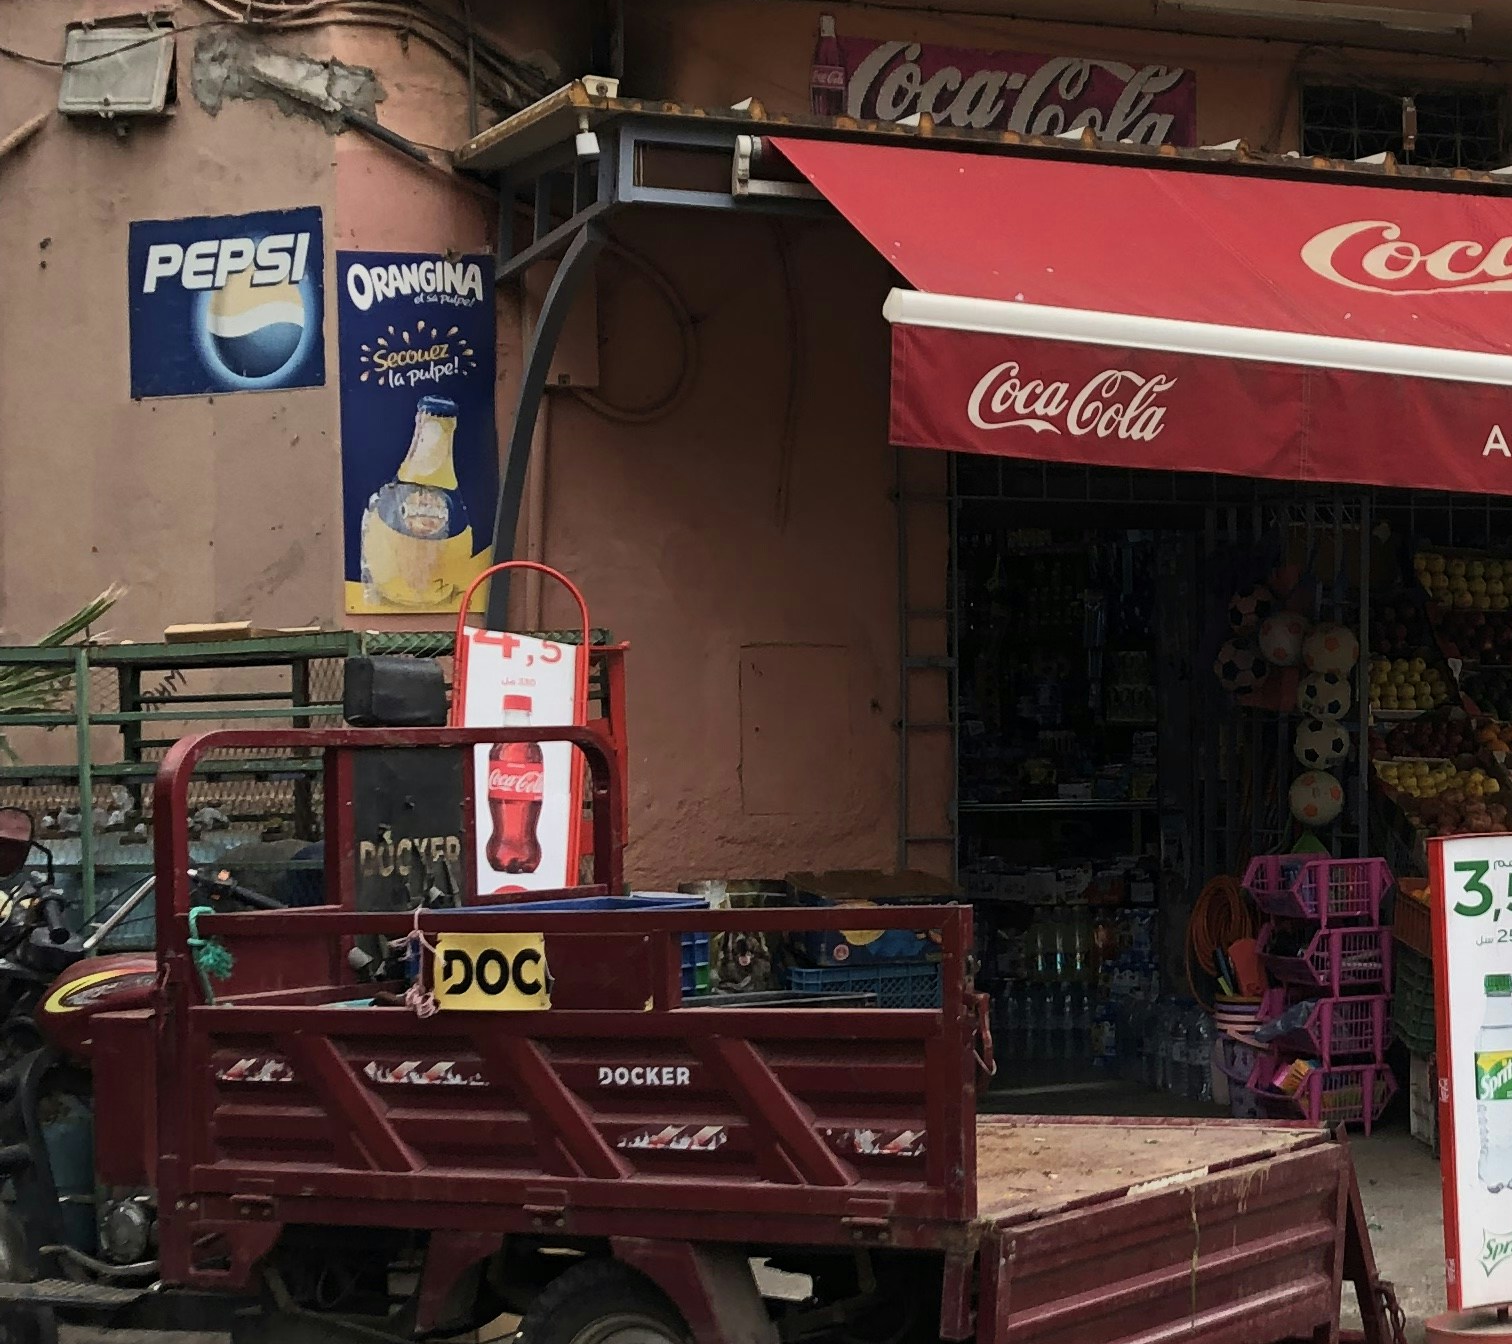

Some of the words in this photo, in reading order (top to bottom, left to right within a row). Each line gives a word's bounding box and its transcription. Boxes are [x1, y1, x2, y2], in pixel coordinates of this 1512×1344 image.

[142, 232, 311, 294] PEPSI
[347, 260, 484, 311] ORANGINA
[373, 343, 449, 372] Secouez
[388, 369, 406, 389] la
[406, 356, 460, 387] pulpe!
[598, 1066, 691, 1086] DOCKER
